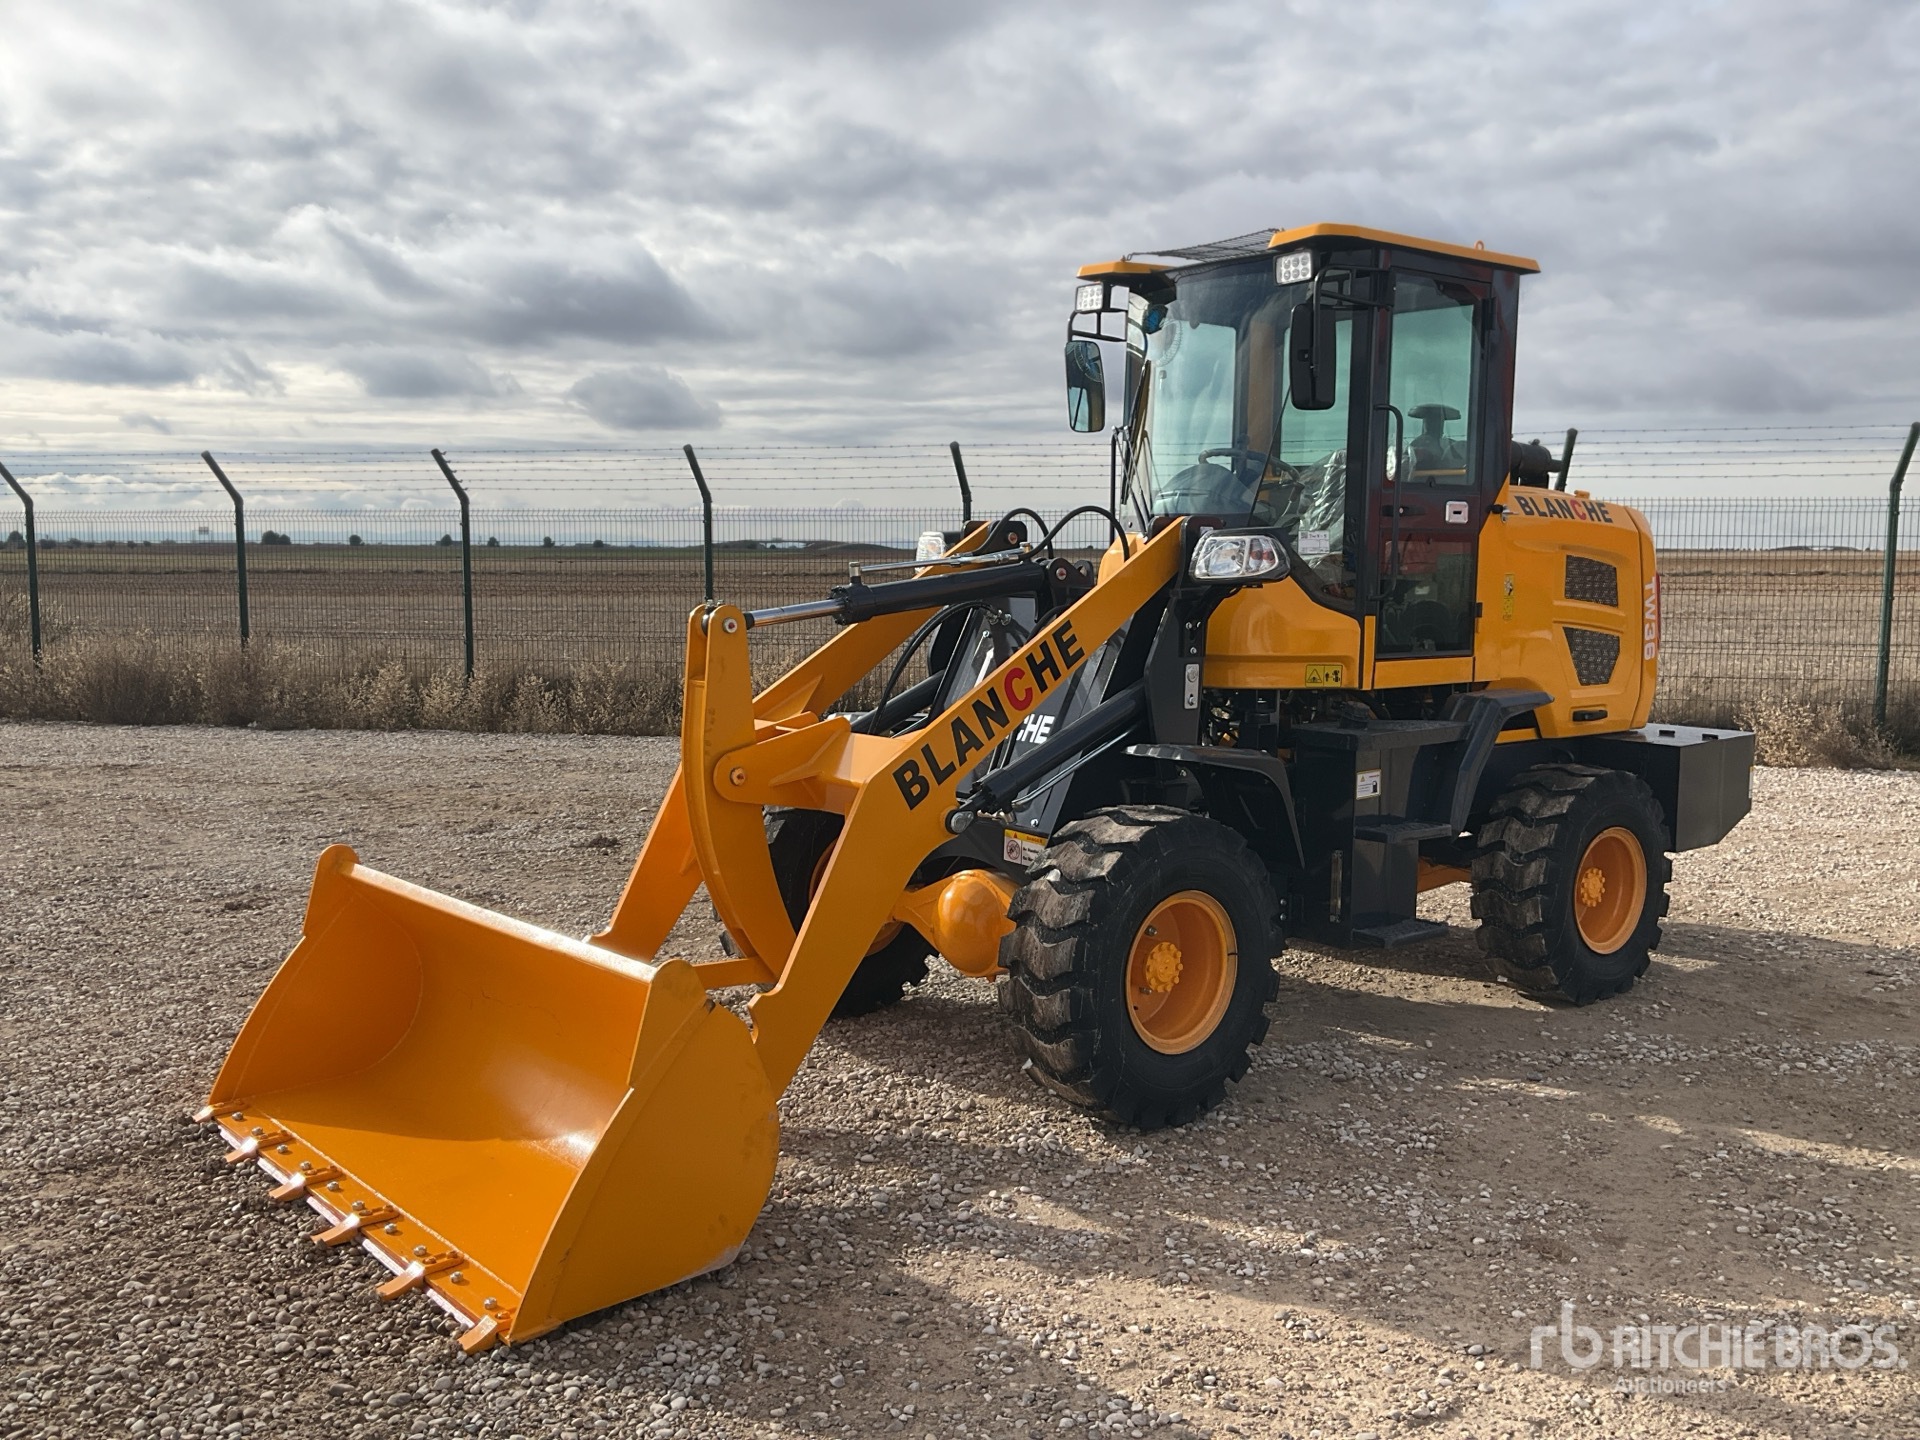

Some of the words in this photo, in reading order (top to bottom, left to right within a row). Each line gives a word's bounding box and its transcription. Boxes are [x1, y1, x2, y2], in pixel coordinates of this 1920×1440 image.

[1514, 495, 1613, 523] BLANCHE
[1644, 576, 1656, 660] TW36
[892, 619, 1085, 810] BLANCHE
